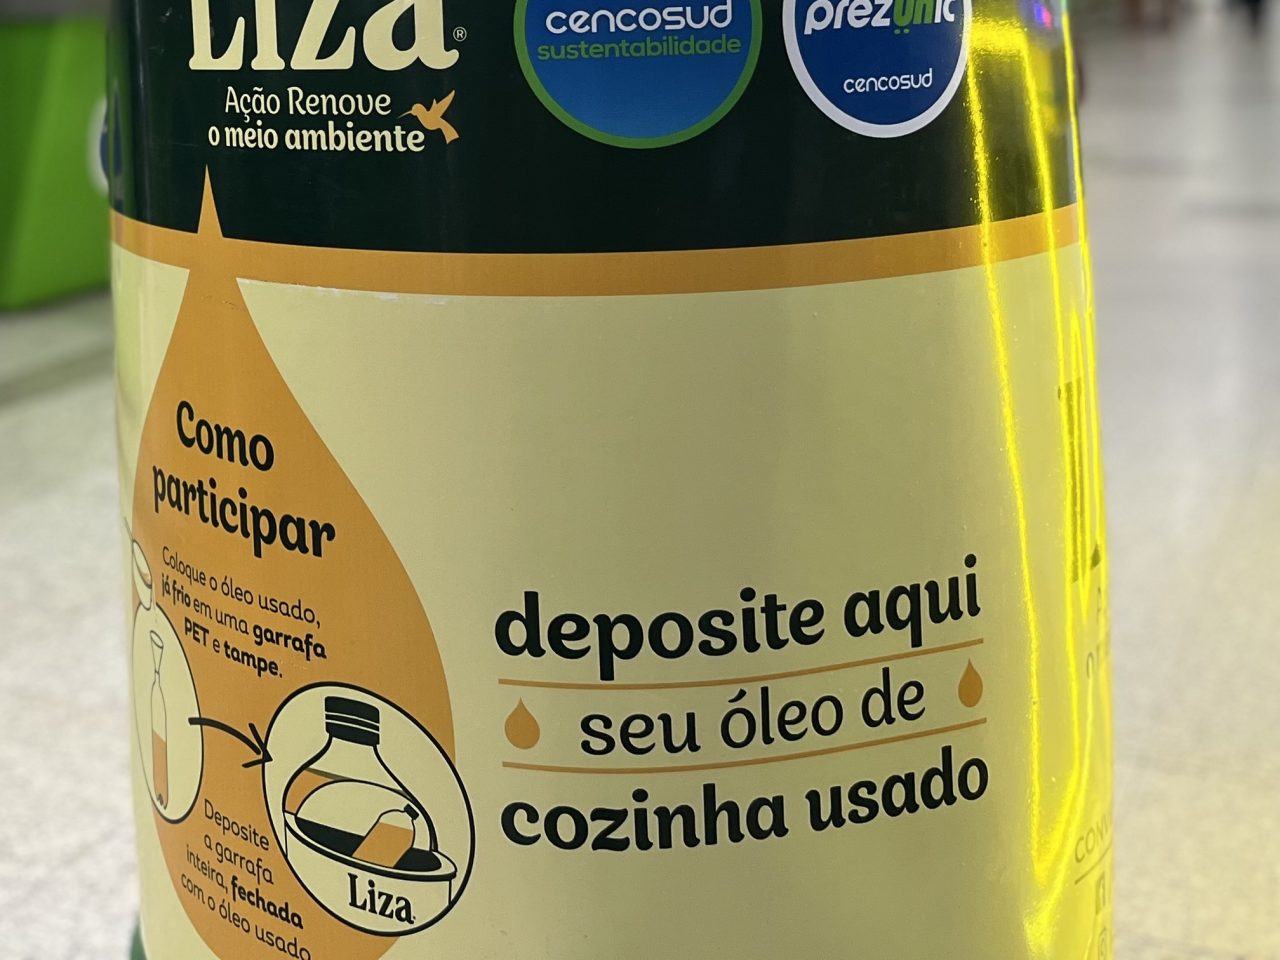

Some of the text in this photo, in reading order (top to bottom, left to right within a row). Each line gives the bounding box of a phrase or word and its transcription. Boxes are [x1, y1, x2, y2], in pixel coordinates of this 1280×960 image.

[536, 34, 742, 61] sustentabilidade
[843, 67, 933, 94] cencosud
[208, 119, 426, 152] o meio ambiente
[224, 86, 392, 122] Ação Renove
[176, 400, 274, 471] Como
[152, 465, 336, 558] participar
[161, 573, 327, 661] já frio em uma garrafa
[162, 546, 321, 629] Coloque o óleo usado,
[494, 586, 826, 681] deposite
[843, 553, 981, 648] aqui
[184, 616, 283, 678] PET e tampe.
[580, 666, 926, 755] seu óleo de
[204, 798, 270, 851] Deposite
[500, 744, 989, 852] cozinha usado
[186, 844, 304, 930] inteira, fechada
[203, 833, 274, 885] a garrafa
[181, 873, 312, 960] com o óleo usado
[347, 872, 415, 925] Liza
